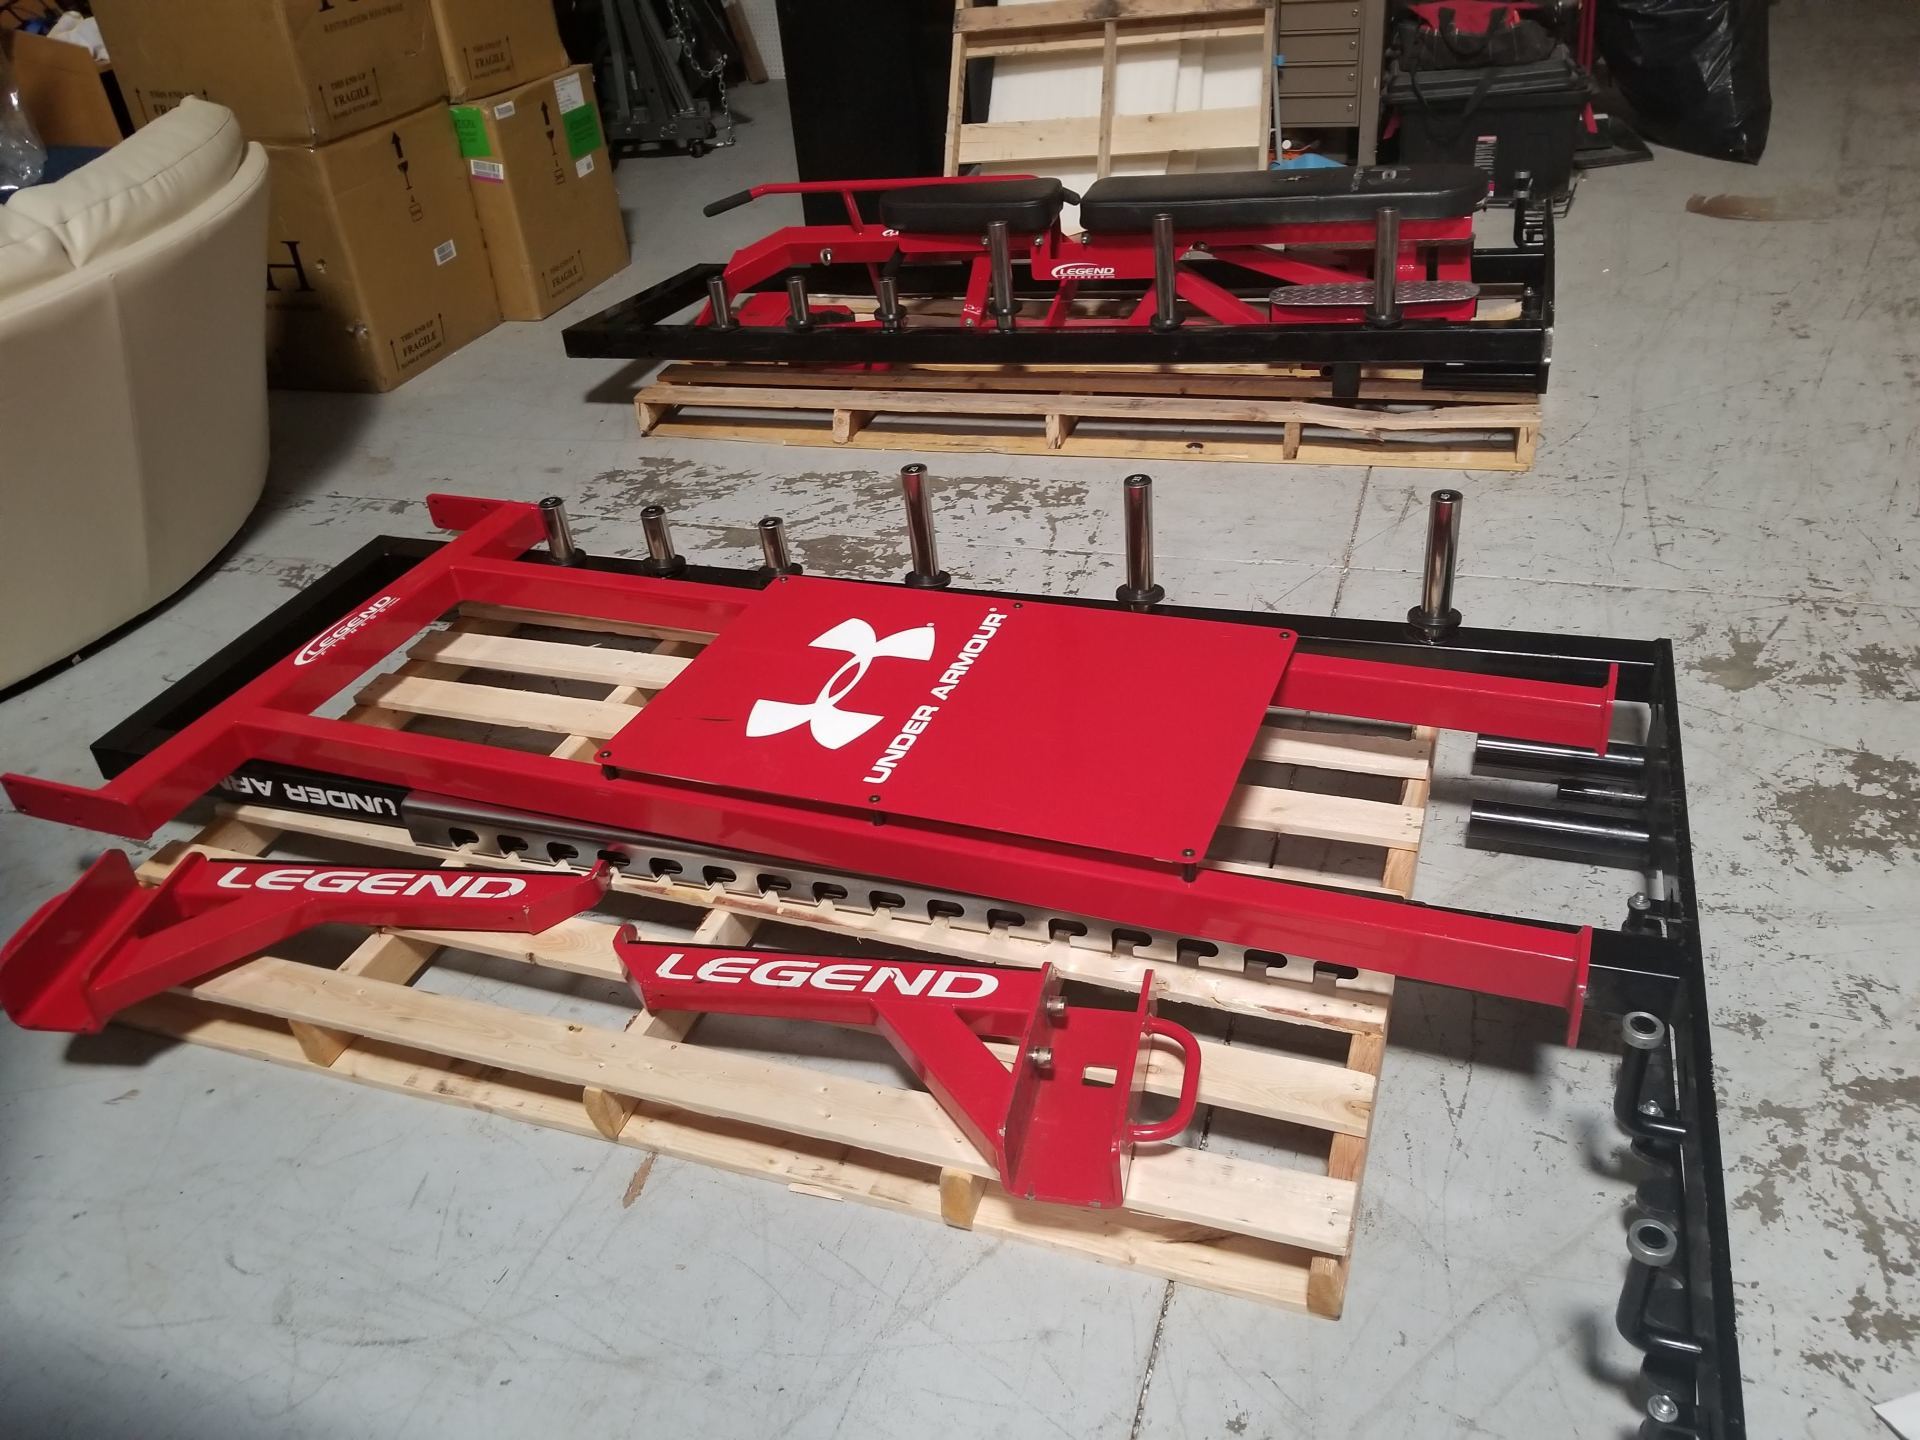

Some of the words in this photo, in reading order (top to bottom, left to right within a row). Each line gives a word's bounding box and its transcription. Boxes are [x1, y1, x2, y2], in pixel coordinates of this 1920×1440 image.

[333, 85, 370, 107] FRAGILE
[1059, 267, 1116, 276] LEGEND
[403, 330, 438, 357] FRAGILE
[306, 595, 392, 657] LEGEND
[863, 705, 941, 784] UNDER
[930, 613, 1009, 701] ARMOUR
[282, 782, 398, 817] UNDER
[216, 866, 527, 899] LEGEND
[655, 953, 999, 999] LEGEND
